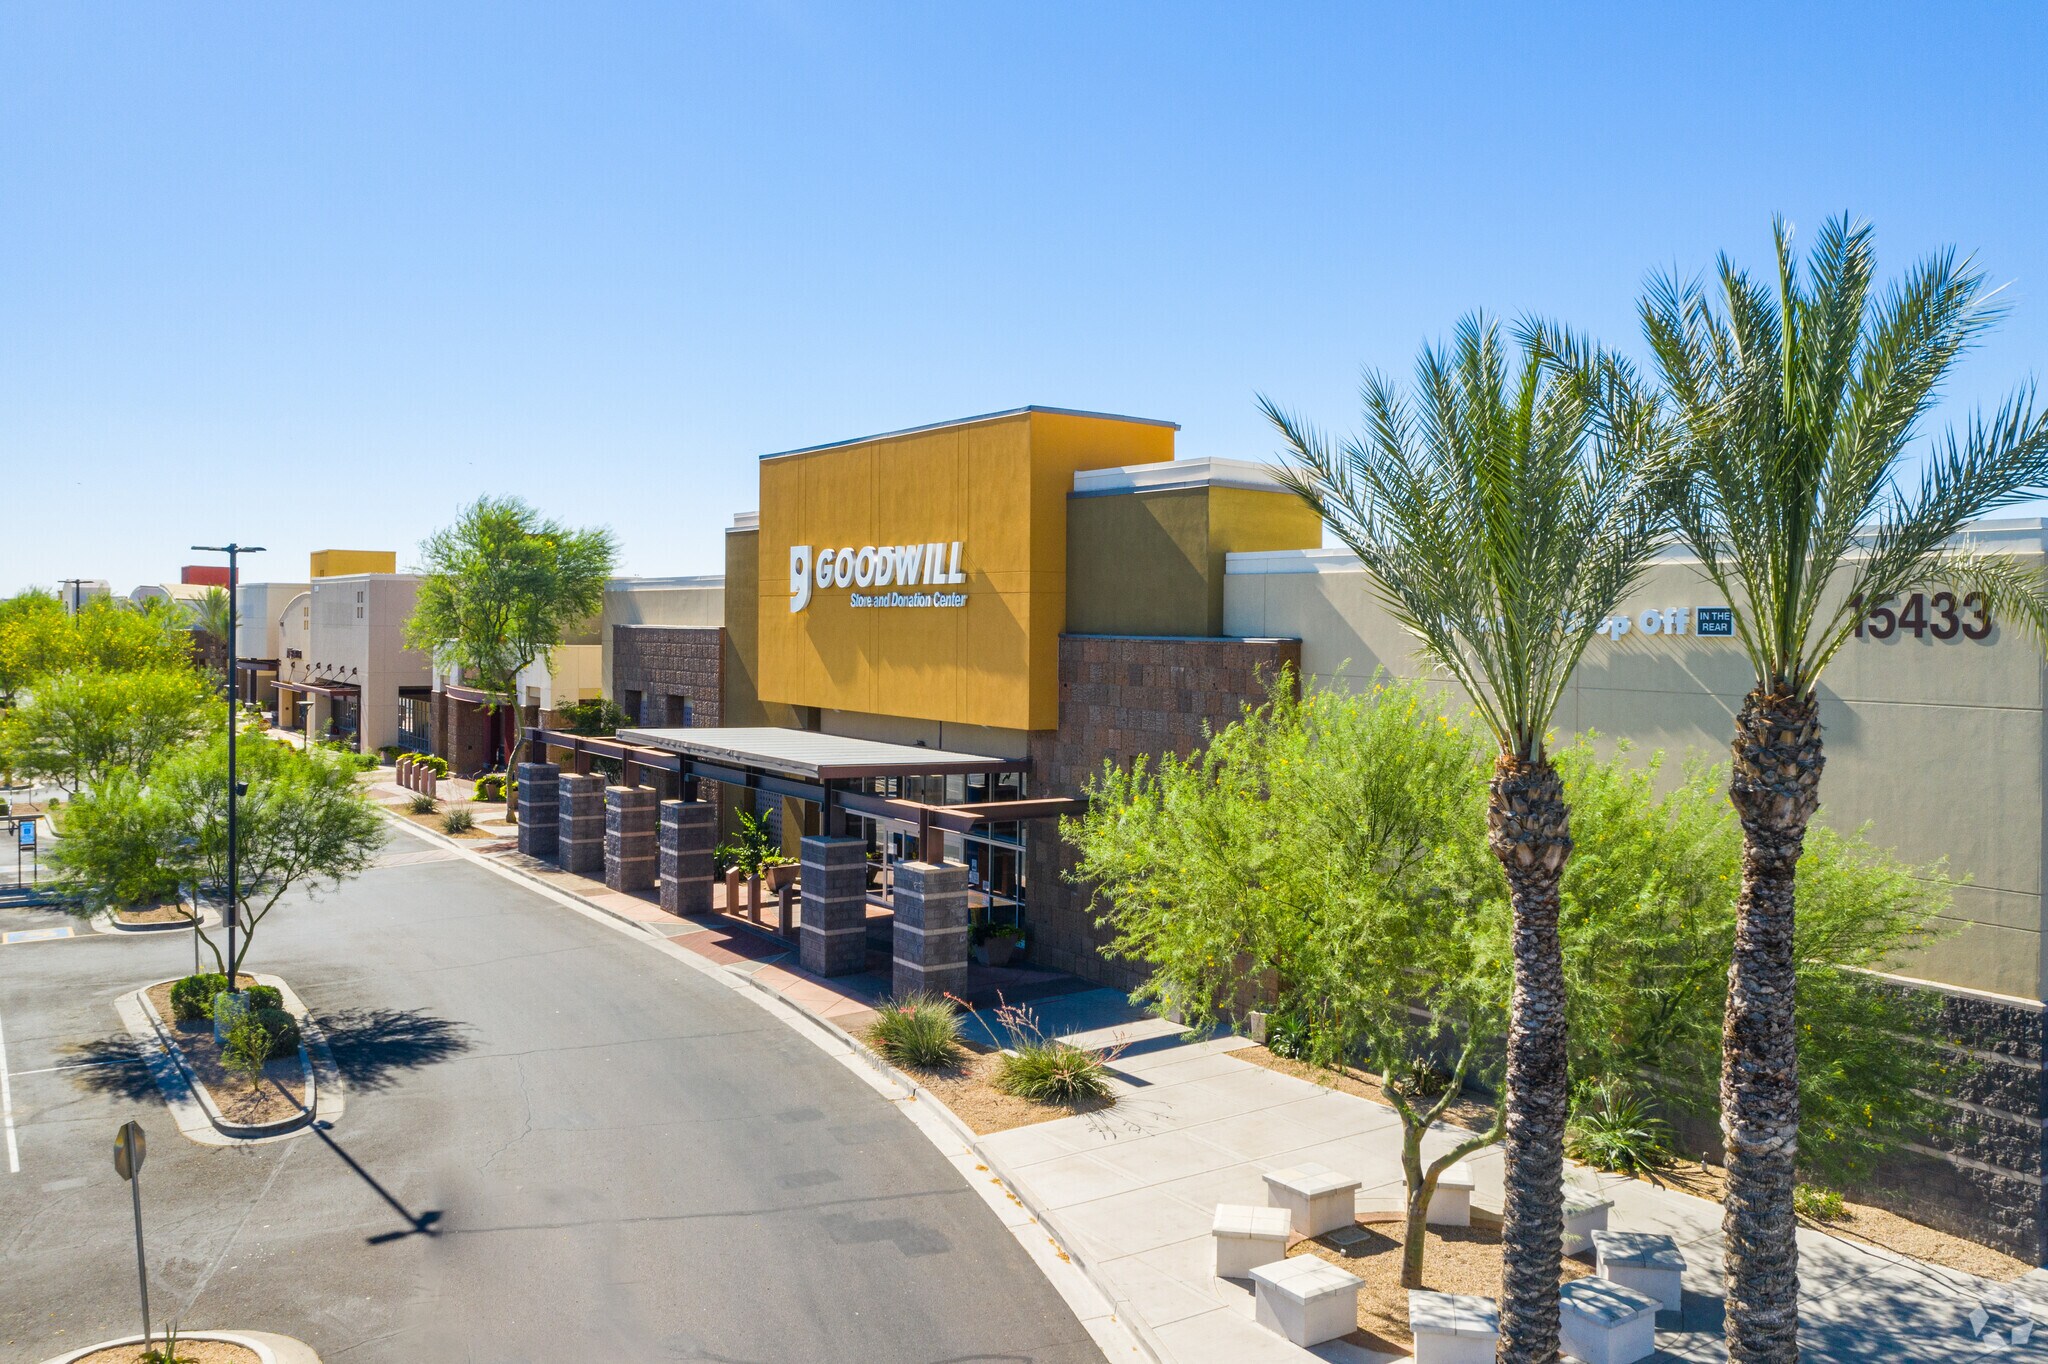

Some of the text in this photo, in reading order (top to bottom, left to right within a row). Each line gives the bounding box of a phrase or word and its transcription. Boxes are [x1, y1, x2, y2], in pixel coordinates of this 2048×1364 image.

[815, 541, 966, 588] GOODWILL
[850, 591, 967, 607] Store and Donation Center
[1639, 607, 1690, 635] Off
[1700, 611, 1730, 620] IN THE
[1850, 591, 1993, 639] 15433
[1702, 622, 1728, 631] REAR
